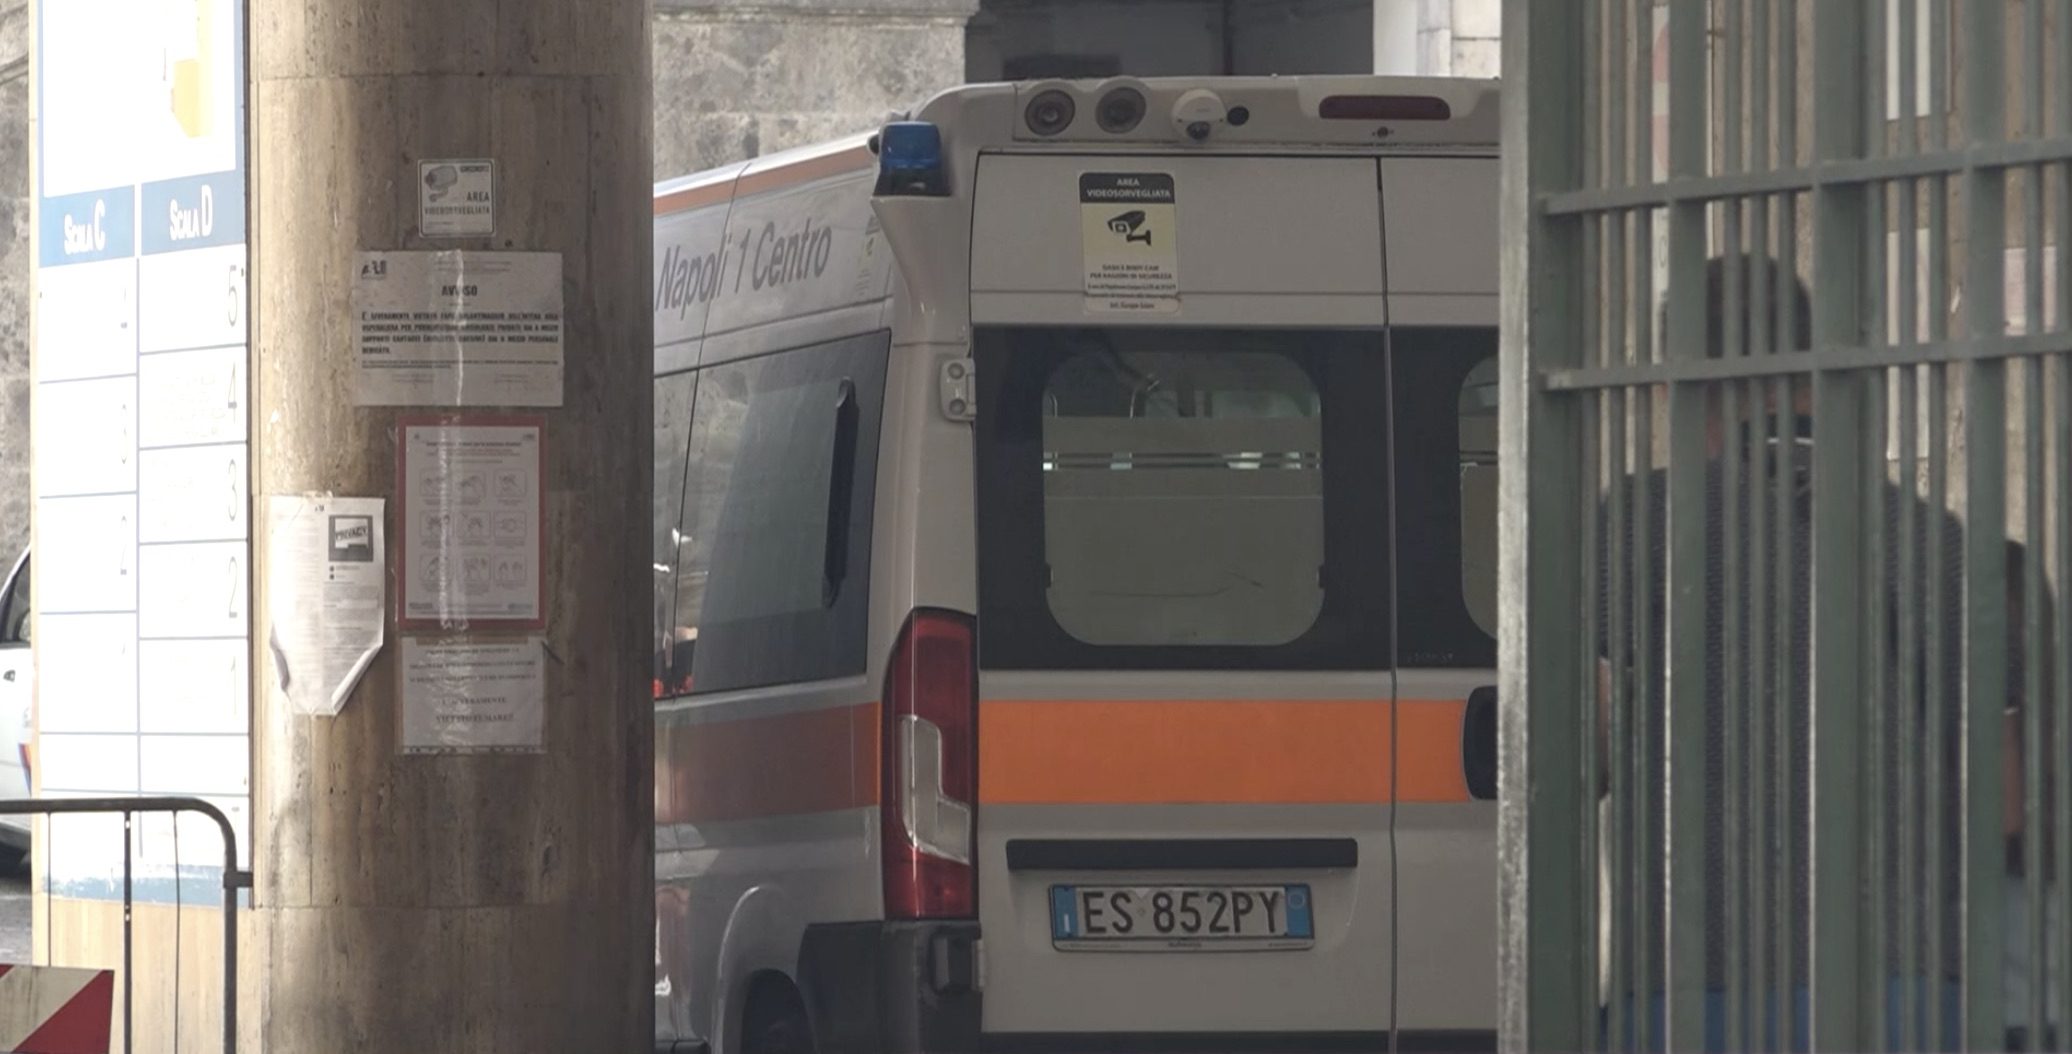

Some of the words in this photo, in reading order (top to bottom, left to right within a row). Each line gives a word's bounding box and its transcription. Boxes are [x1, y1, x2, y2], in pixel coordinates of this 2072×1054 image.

[466, 191, 490, 202] AREA
[1086, 188, 1171, 199] VIDEOSORVEGLIATA
[1117, 178, 1140, 187] AREA
[94, 199, 105, 251] C
[201, 184, 213, 237] D
[655, 232, 732, 321] Napoli
[735, 228, 751, 294] 1
[752, 220, 832, 292] Centro
[228, 265, 238, 327] 5
[228, 458, 238, 521] 3
[335, 525, 367, 541] PRIVACY
[1083, 891, 1134, 934] ES
[1153, 891, 1279, 934] 852PY
